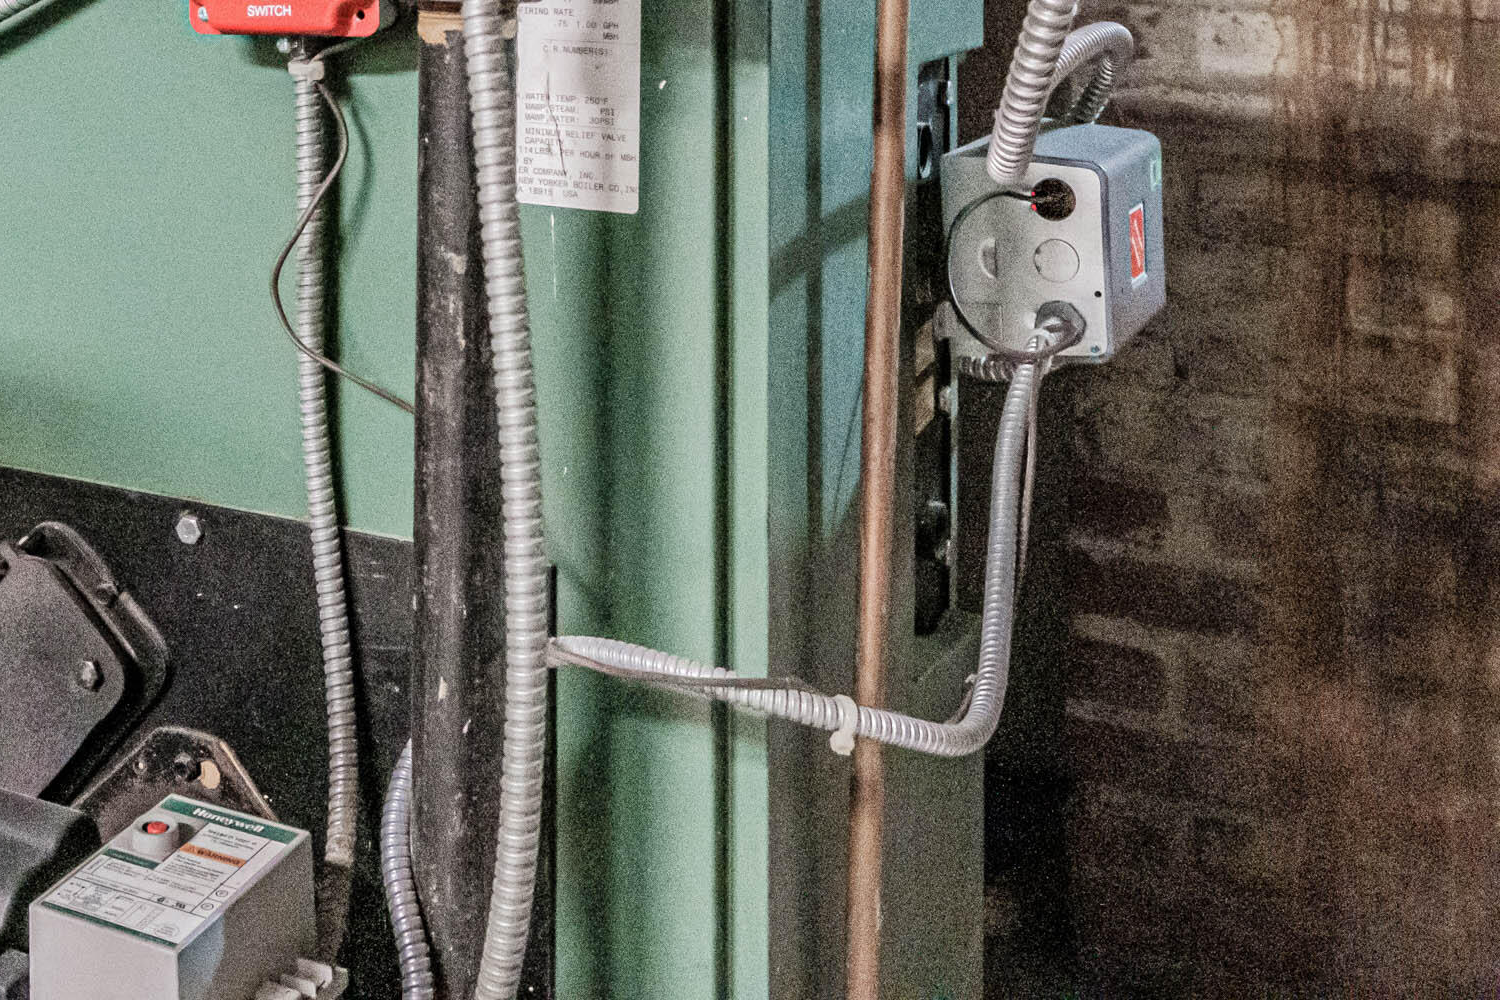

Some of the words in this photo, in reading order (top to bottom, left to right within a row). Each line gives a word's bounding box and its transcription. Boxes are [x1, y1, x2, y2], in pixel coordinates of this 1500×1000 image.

[247, 4, 292, 17] SWITCH
[601, 132, 627, 143] VALVE
[539, 178, 569, 188] YORKER
[572, 182, 605, 192] BOILER
[562, 190, 578, 199] USA
[192, 805, 266, 834] Honeywell
